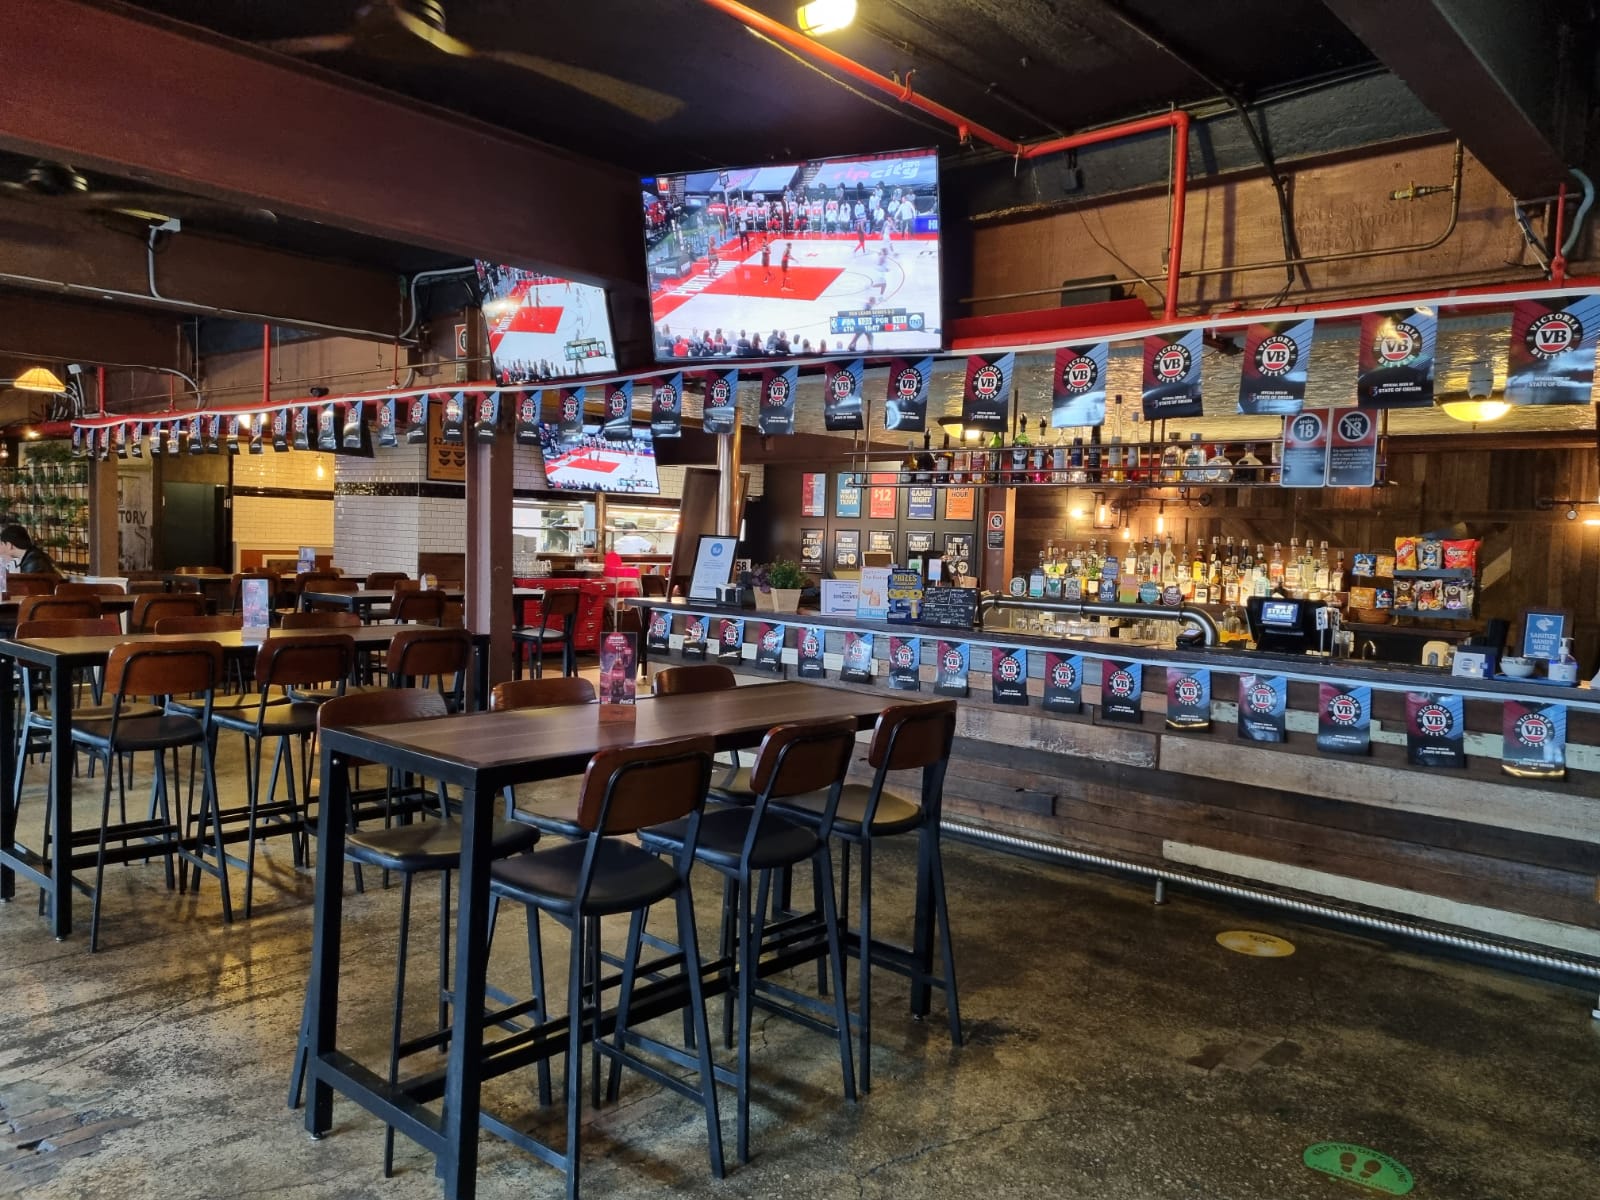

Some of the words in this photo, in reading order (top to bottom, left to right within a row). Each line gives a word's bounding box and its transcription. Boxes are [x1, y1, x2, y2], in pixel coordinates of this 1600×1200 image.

[1530, 313, 1579, 332] VICTORIA
[1541, 330, 1568, 344] VB
[1258, 336, 1296, 352] VICTORIA
[1385, 340, 1410, 353] VB
[1155, 345, 1189, 360] VICTORIA
[1266, 351, 1286, 362] VB
[1066, 358, 1096, 372] VICTORIA
[1163, 358, 1180, 370] VB
[833, 370, 854, 382] VICTORIA
[898, 369, 920, 380] VICTORIA
[975, 366, 1002, 378] VICTORIA
[1072, 370, 1088, 380] VB
[1157, 371, 1186, 383] BITTER
[1258, 365, 1291, 377] BITTER
[837, 382, 849, 390] VB
[902, 380, 914, 388] VB
[981, 378, 994, 388] VB
[1066, 382, 1093, 393] BITTER
[975, 390, 998, 400] BITTER
[1298, 424, 1314, 438] 18
[874, 489, 891, 501] $12
[118, 510, 147, 525] TORY
[736, 562, 747, 571] 58
[1177, 677, 1200, 688] VICTORIA
[1249, 684, 1276, 696] VICTORIA
[1330, 694, 1359, 708] VICTORIA
[1250, 704, 1273, 713] BITTER
[1336, 706, 1352, 714] VB
[1418, 705, 1449, 718] VICTORIA
[1332, 717, 1357, 726] BITTER
[1425, 716, 1442, 725] VB
[1516, 714, 1552, 727] VICTORIA
[1421, 728, 1448, 736] BITTER
[1525, 726, 1544, 735] VB
